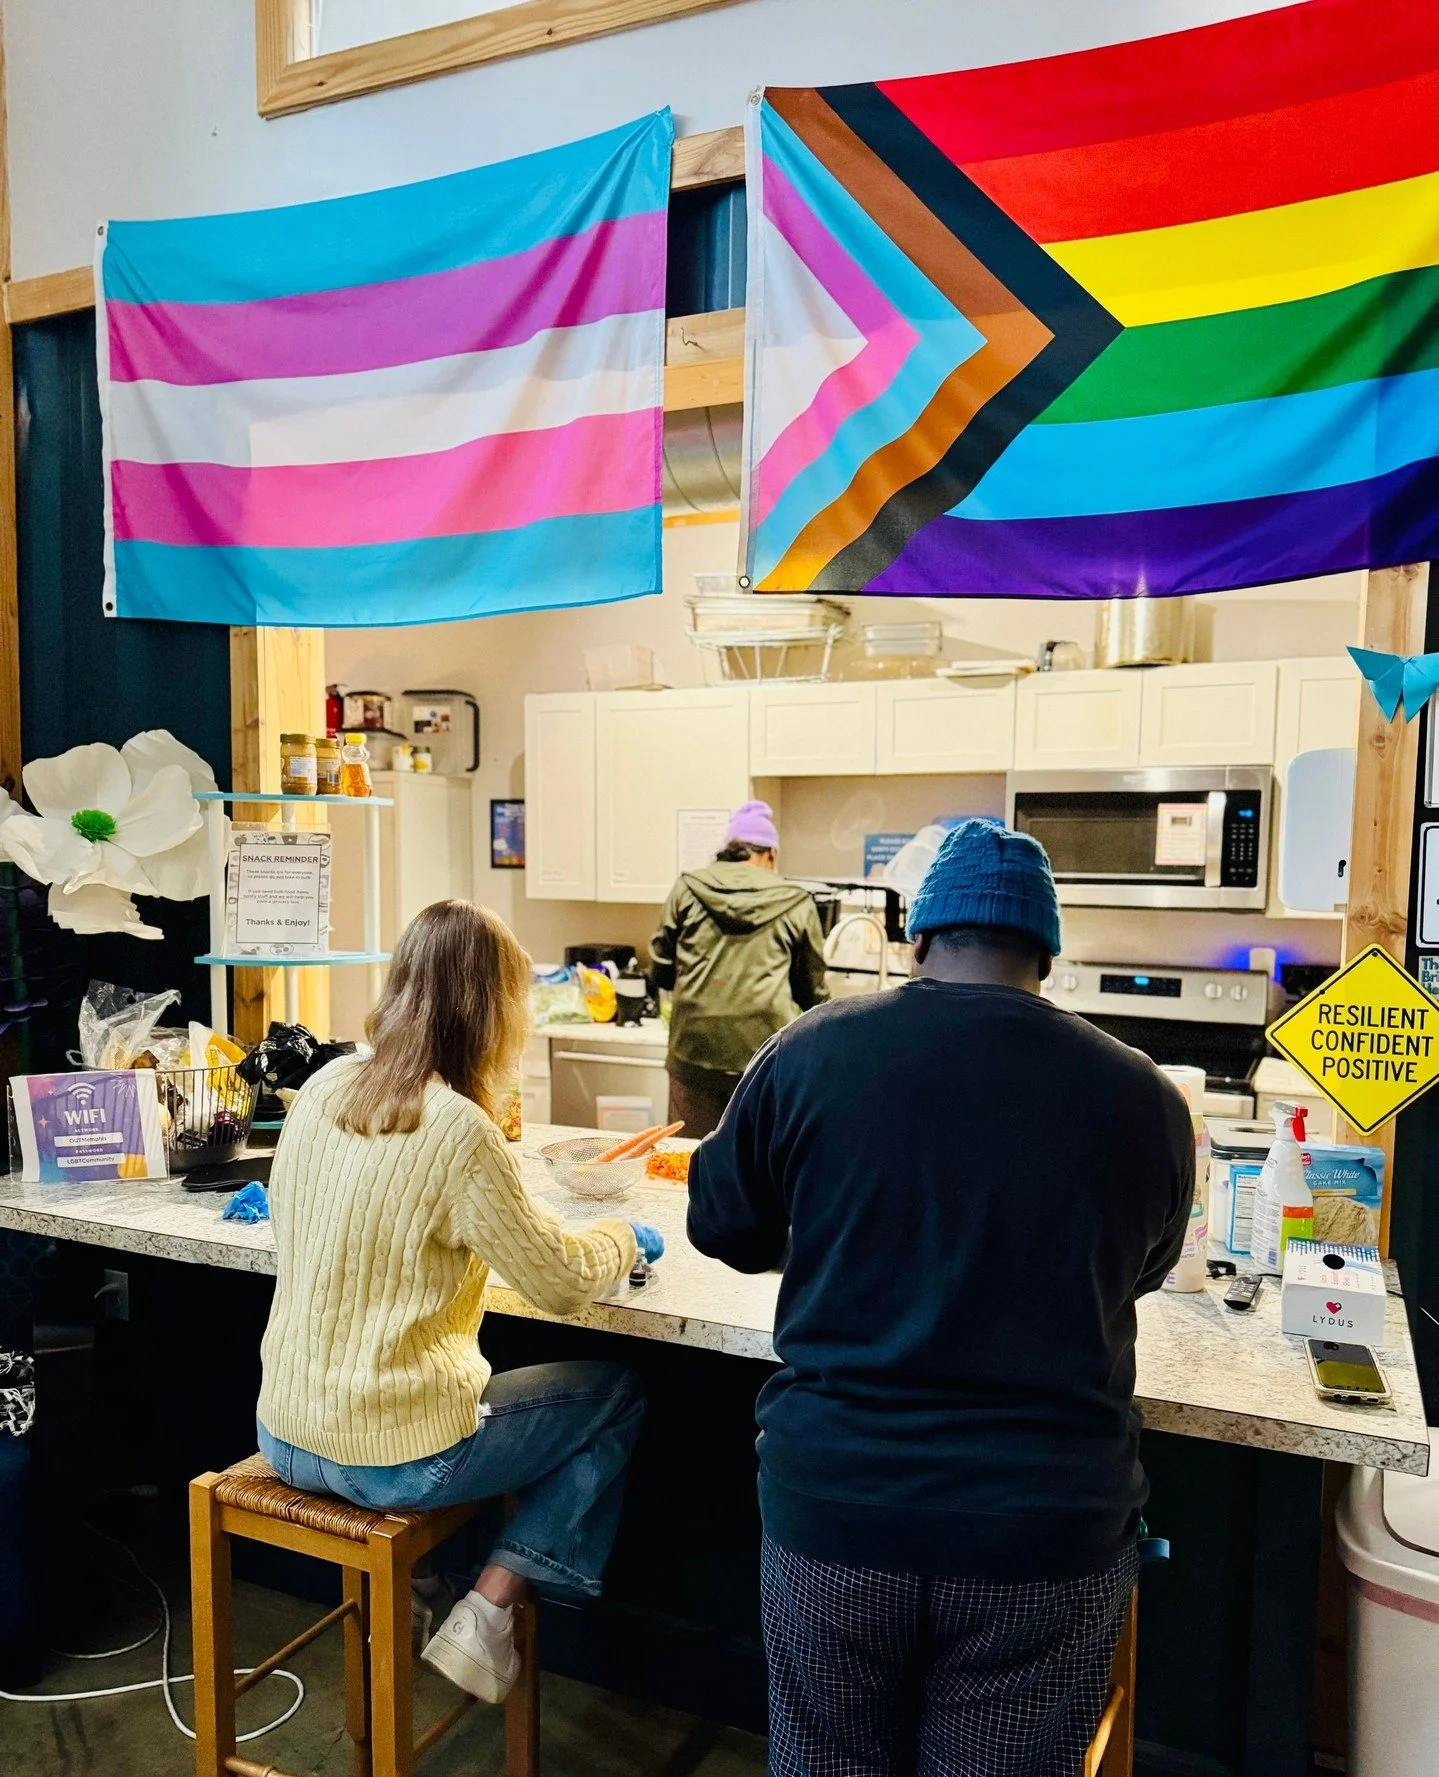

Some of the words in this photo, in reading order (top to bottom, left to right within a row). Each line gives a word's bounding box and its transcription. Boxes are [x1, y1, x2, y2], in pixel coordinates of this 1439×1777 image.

[242, 855, 273, 863] SNACK
[273, 856, 319, 864] REMINDER
[245, 918, 275, 926] Thanks
[284, 919, 310, 927] Enjoy!
[1318, 1003, 1429, 1030] RESILIENT
[1311, 1029, 1434, 1057] CONFIDENT
[1322, 1056, 1418, 1083] POSITIVE
[64, 1108, 107, 1126] WIFI
[66, 1156, 115, 1165] LGBTCommunity
[1332, 1169, 1360, 1179] White
[1312, 1315, 1354, 1328] LYDUS
